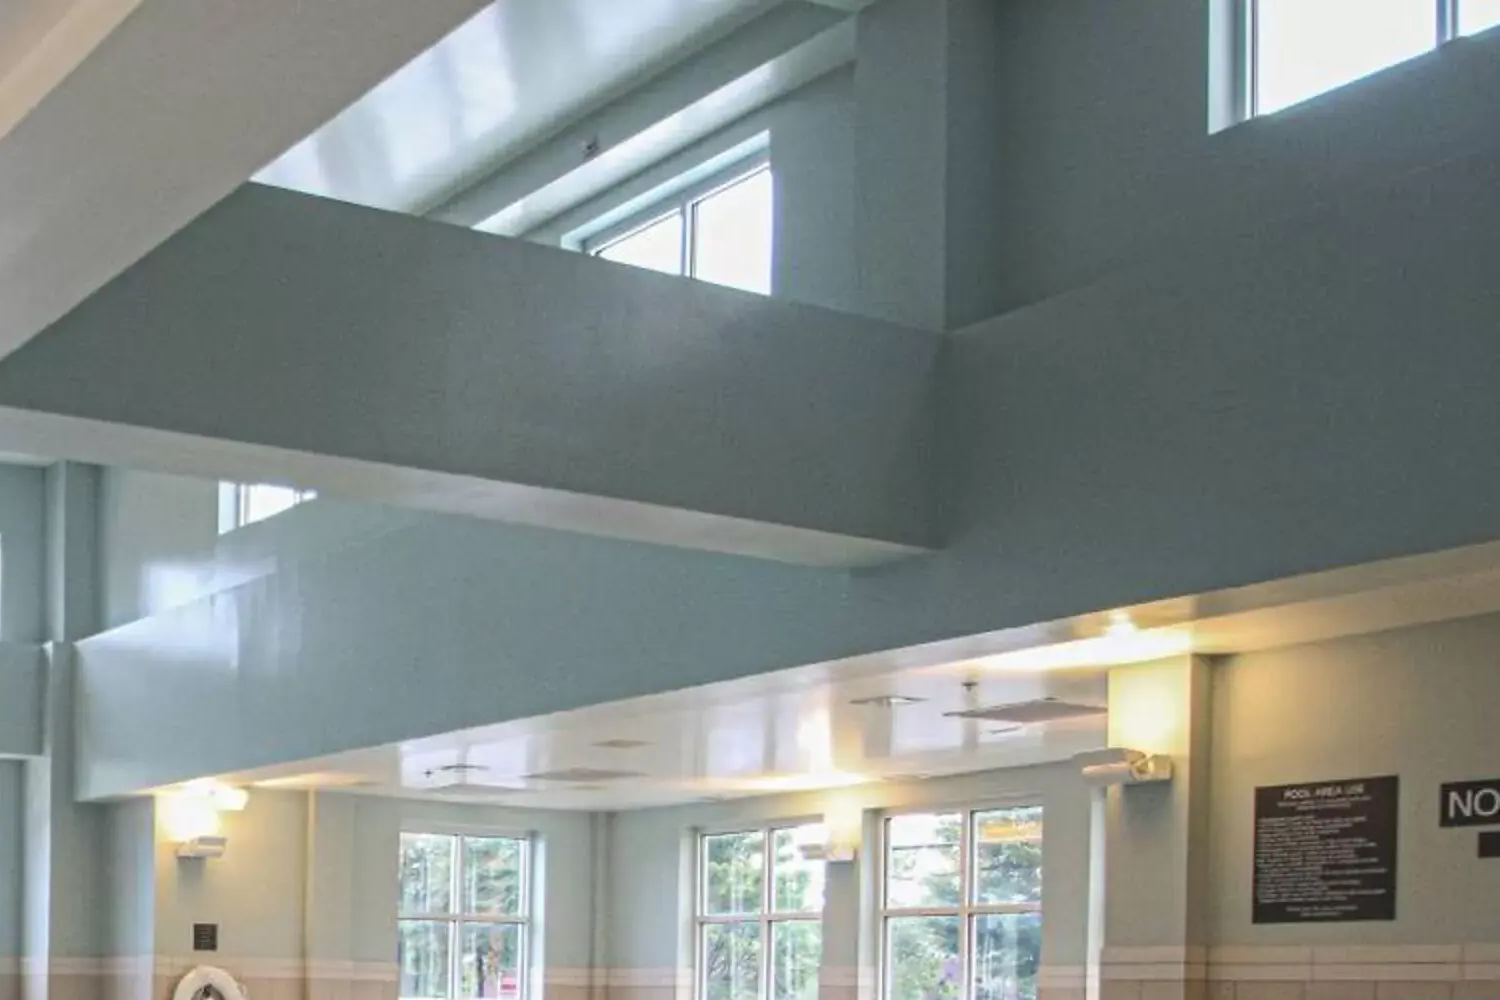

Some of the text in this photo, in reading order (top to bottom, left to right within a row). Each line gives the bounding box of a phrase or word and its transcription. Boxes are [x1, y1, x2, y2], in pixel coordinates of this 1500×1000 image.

[1283, 789, 1310, 800] POOL
[1315, 786, 1342, 796] AREA
[1449, 788, 1500, 819] NO
